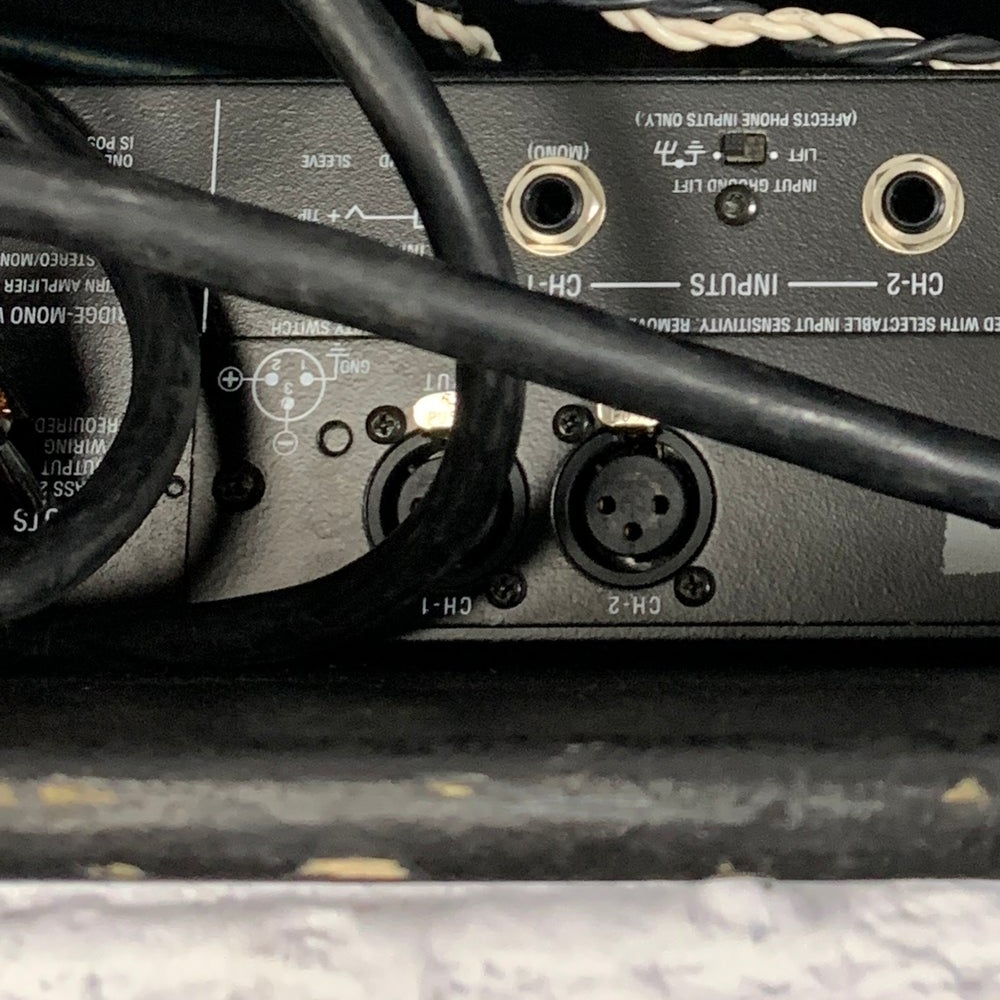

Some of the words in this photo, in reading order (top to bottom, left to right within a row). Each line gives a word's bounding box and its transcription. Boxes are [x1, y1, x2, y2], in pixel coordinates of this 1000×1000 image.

[686, 112, 738, 127] INPUTS
[741, 112, 789, 127] PHONE
[793, 110, 857, 127] (AFFECTS
[119, 135, 134, 151] IS
[527, 141, 589, 160] (MONO)
[300, 154, 351, 169] SLEEVE
[788, 147, 817, 162] LIFT
[671, 178, 703, 194] LIFT
[773, 178, 817, 194] INPUT
[3, 278, 81, 293] AMPLIFIER
[527, 273, 583, 298] CH-1
[689, 272, 779, 297] INPUTS
[886, 271, 944, 296] CH-2
[10, 305, 126, 324] RIDGE-MONO
[271, 319, 330, 335] SWITCH
[796, 316, 840, 332] INPUT
[843, 316, 937, 332] SELECTABLE
[940, 316, 980, 332] WITH
[271, 358, 282, 371] 2
[339, 359, 371, 375] GND
[283, 381, 294, 395] 3
[43, 438, 107, 455] WIRING
[40, 459, 95, 476] UTPUT
[420, 596, 472, 616] CH-1
[607, 595, 661, 615] CH-2
